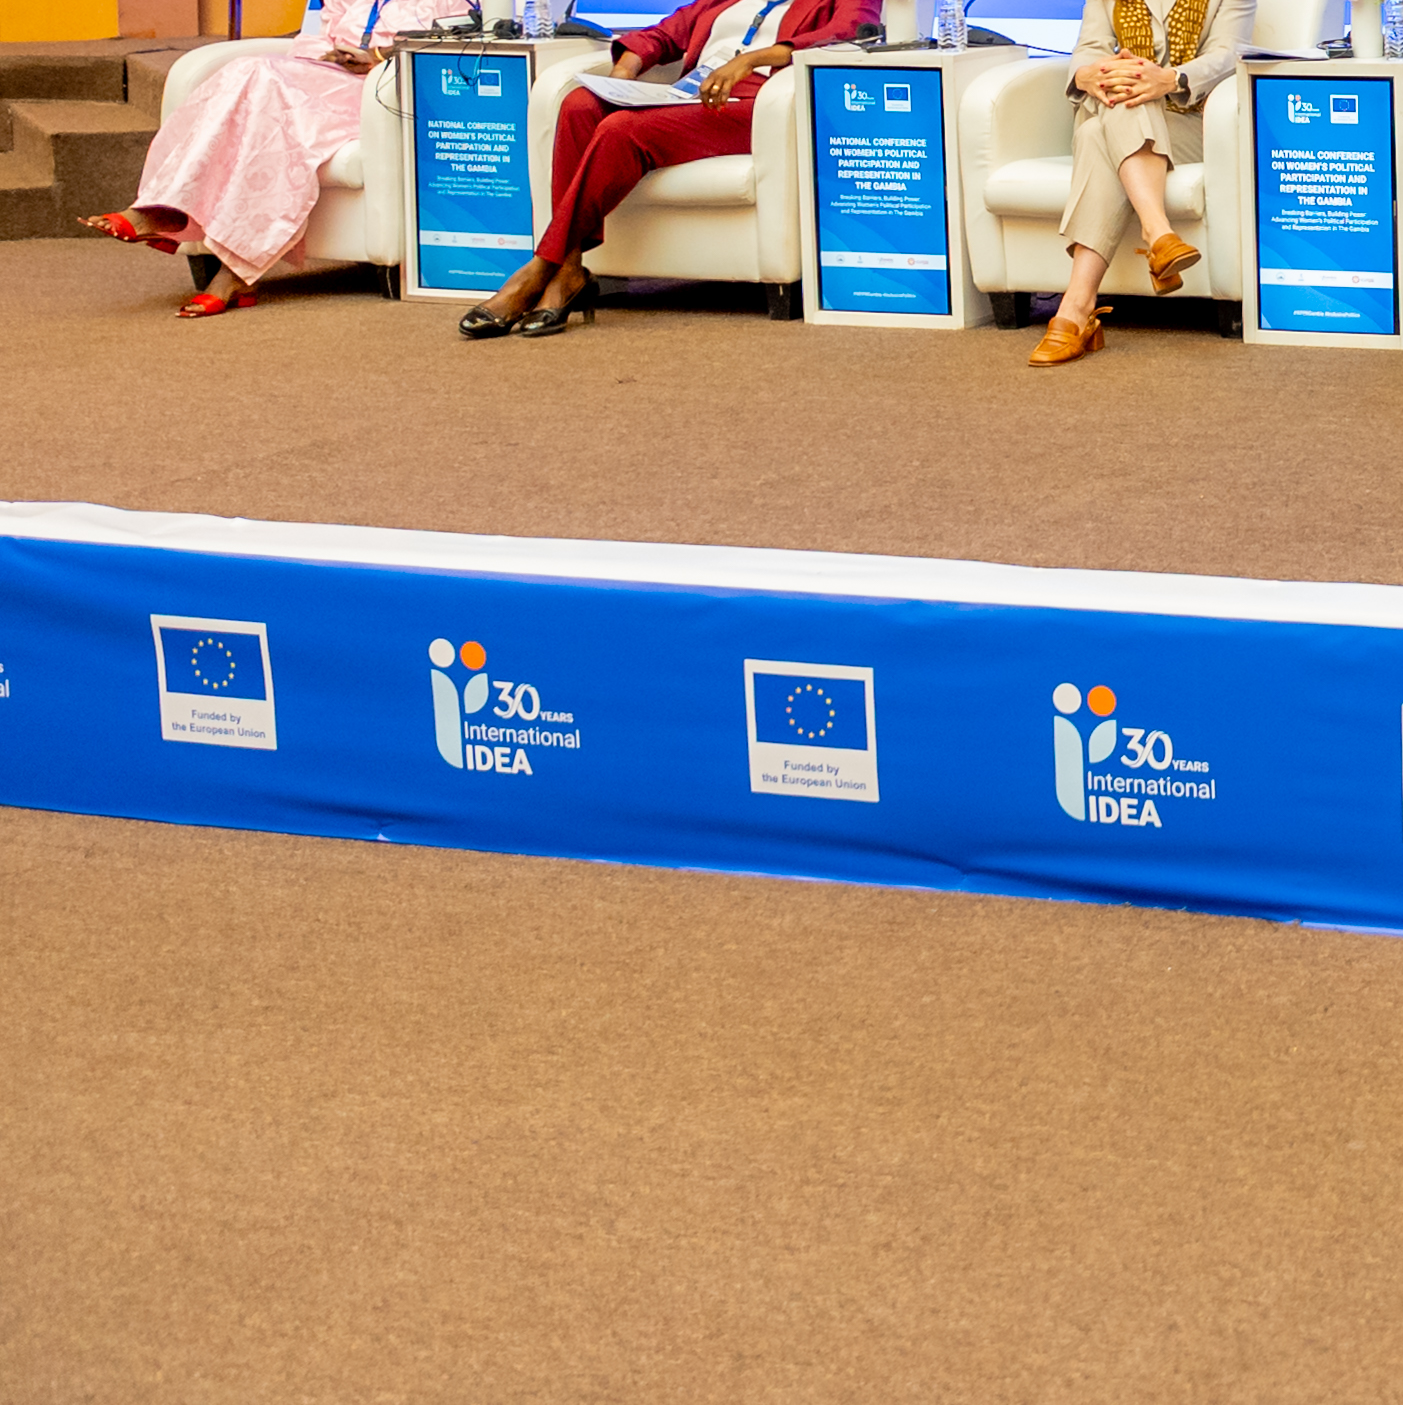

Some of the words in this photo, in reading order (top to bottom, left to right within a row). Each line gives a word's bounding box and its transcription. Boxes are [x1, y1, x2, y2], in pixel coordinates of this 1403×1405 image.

[492, 680, 541, 721] 30
[540, 710, 574, 724] YEARS
[172, 722, 187, 731] the
[189, 723, 235, 736] European
[237, 728, 266, 738] Union
[191, 709, 227, 721] Funded
[230, 714, 241, 725] by
[464, 721, 580, 748] International
[466, 744, 533, 775] IDEA
